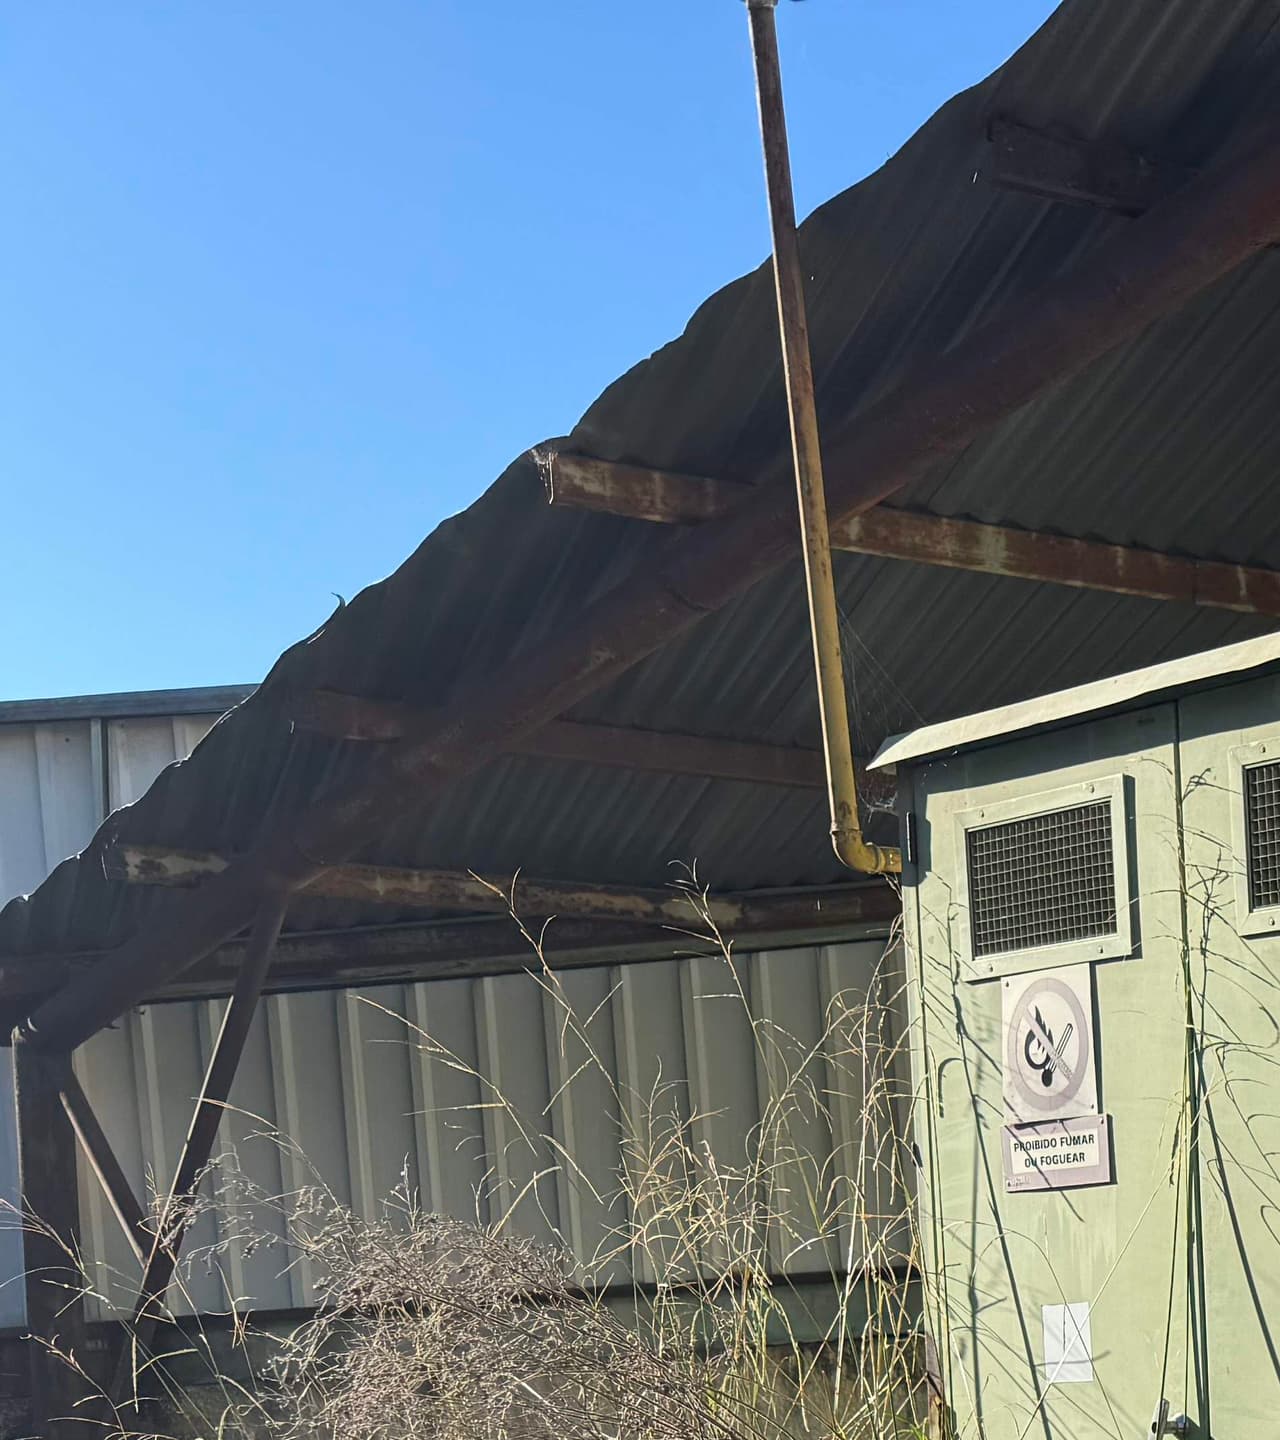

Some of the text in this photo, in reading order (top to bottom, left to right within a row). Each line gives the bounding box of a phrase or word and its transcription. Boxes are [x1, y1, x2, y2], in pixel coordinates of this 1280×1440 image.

[1014, 1134, 1095, 1152] PROIBIDO FUMAR
[1024, 1152, 1085, 1168] OU FOGUEAR
